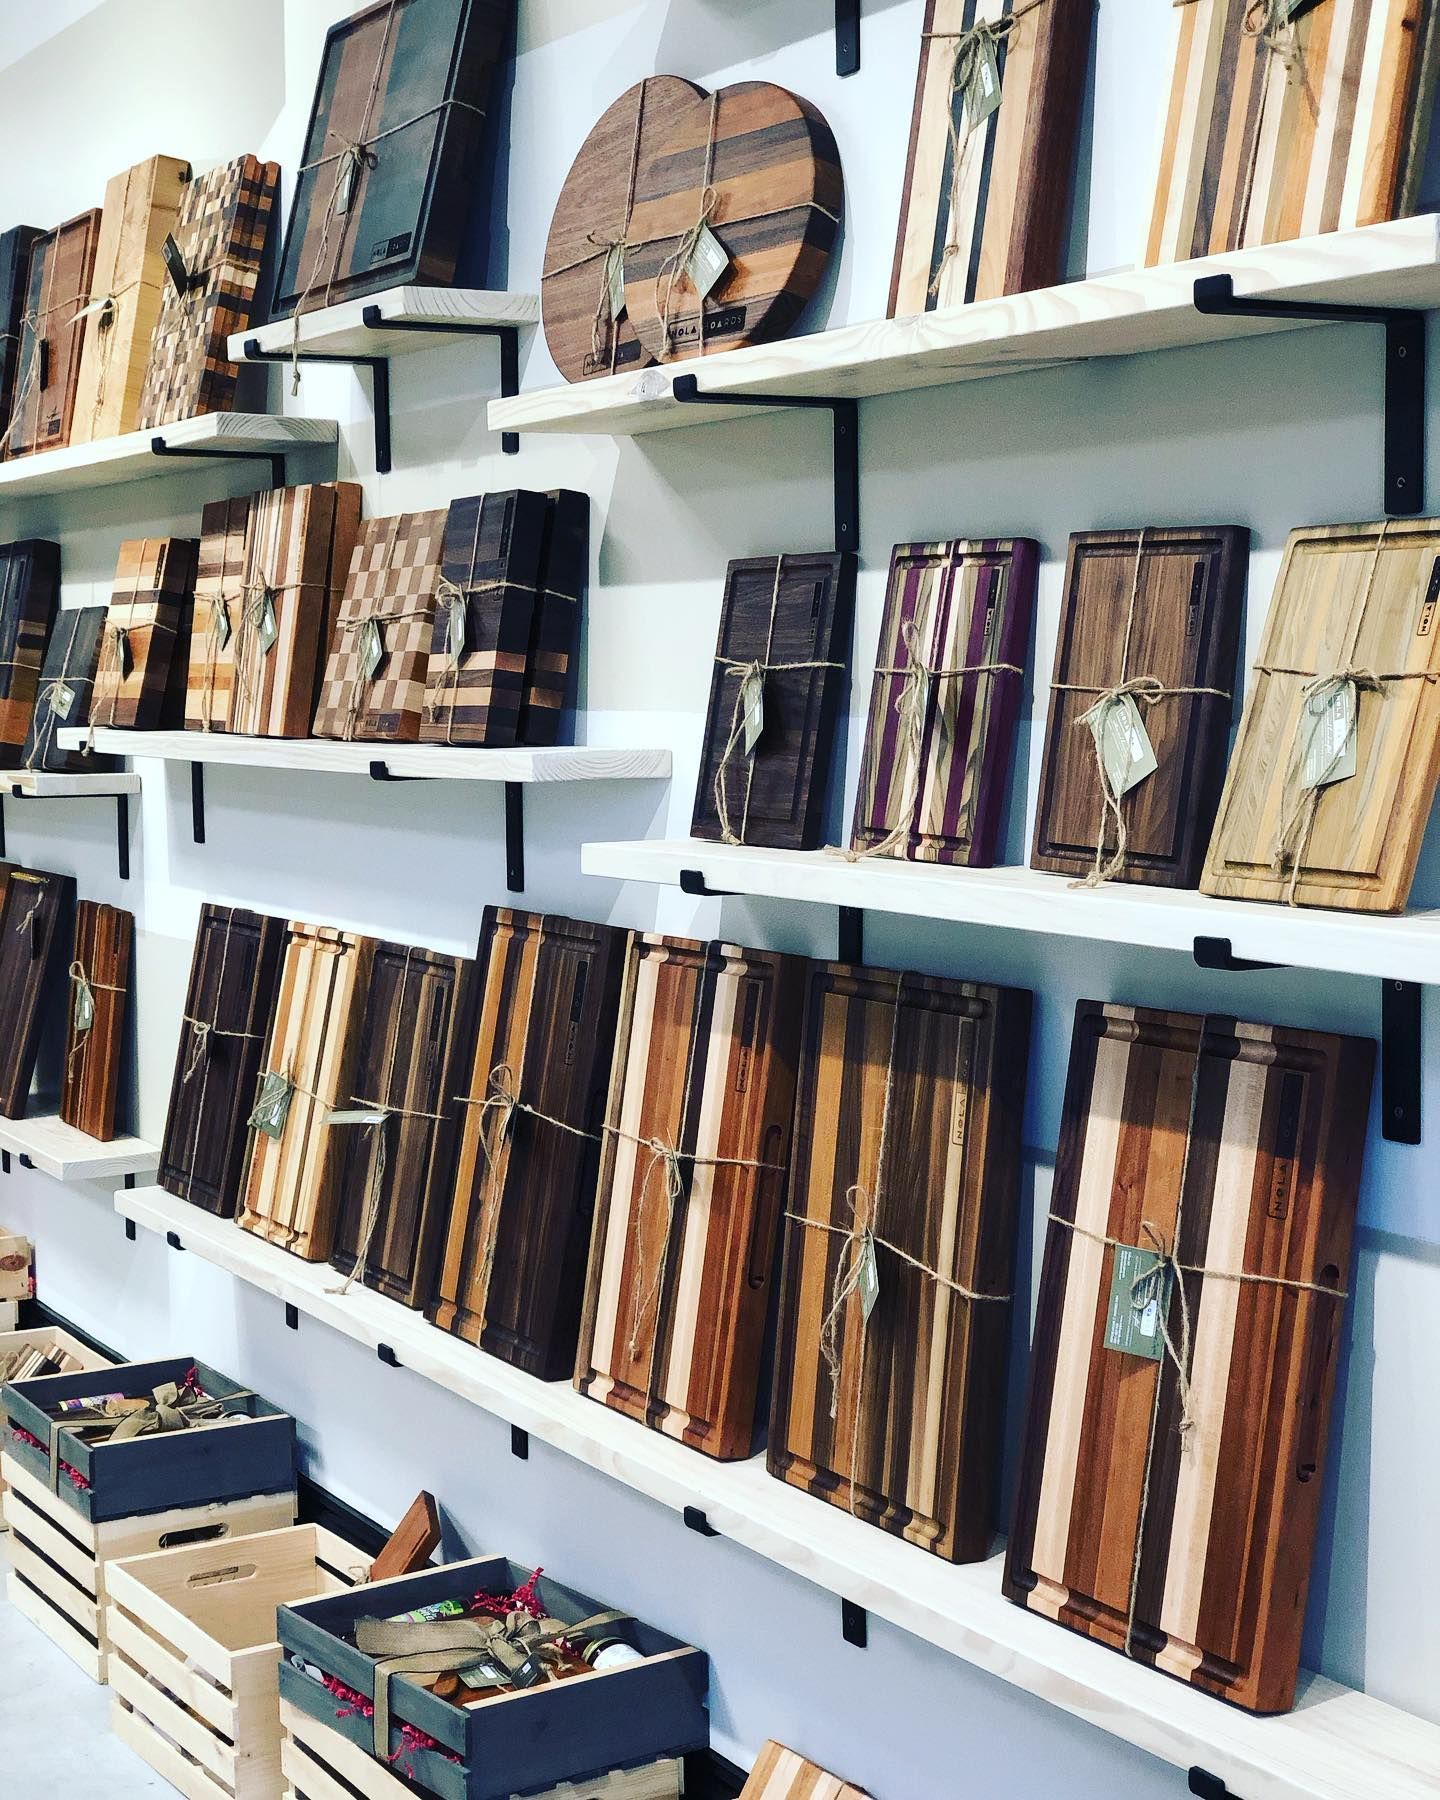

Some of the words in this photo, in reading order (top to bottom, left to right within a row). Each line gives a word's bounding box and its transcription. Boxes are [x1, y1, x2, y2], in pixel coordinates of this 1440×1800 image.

[671, 325, 697, 337] NOLA
[1421, 604, 1433, 632] NOLA
[957, 1099, 966, 1139] NOLA
[1274, 1164, 1287, 1212] NOLA
